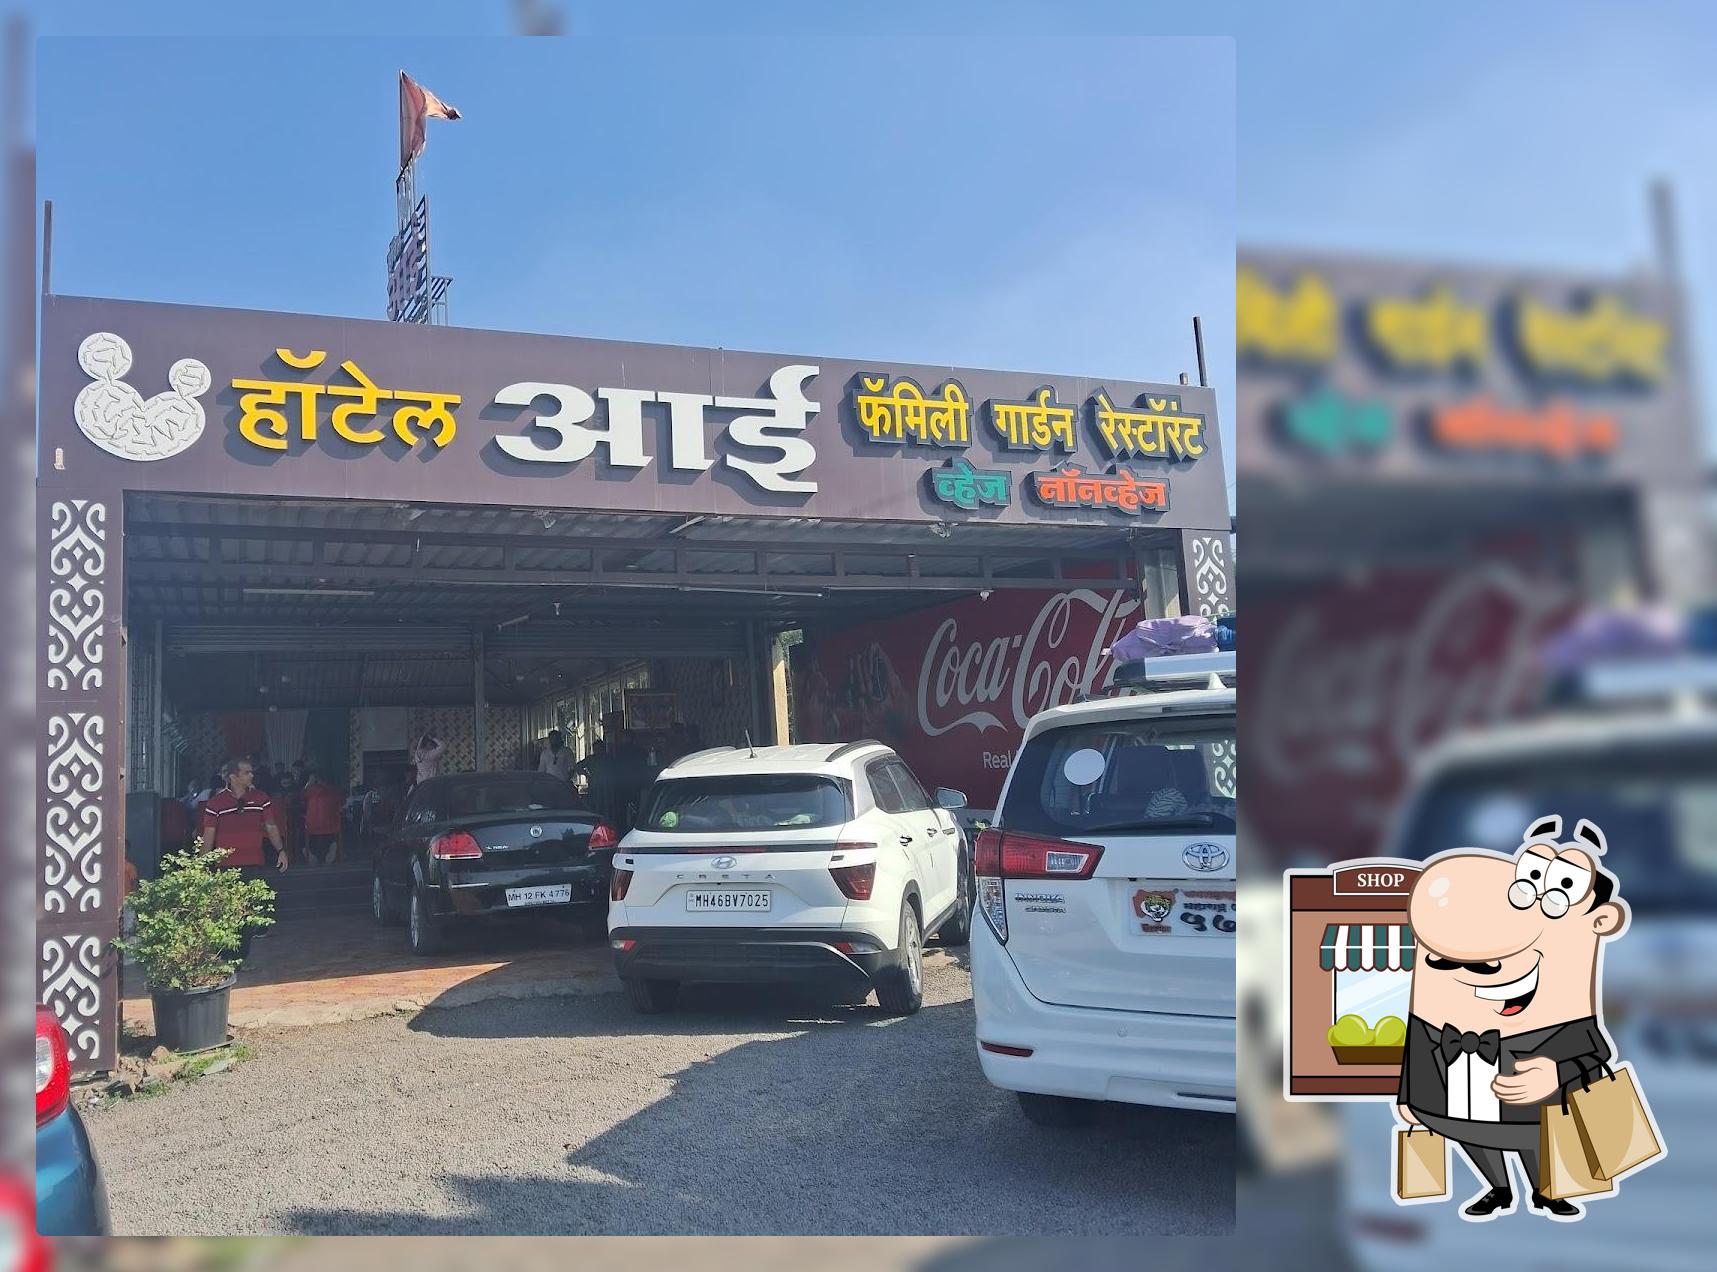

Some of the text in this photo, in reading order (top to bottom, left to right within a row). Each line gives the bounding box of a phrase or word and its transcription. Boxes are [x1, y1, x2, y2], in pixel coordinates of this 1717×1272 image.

[232, 348, 821, 493] हॉटेल आई
[857, 376, 1204, 455] फॅमिली गार्डन रेस्टॉरंट
[936, 466, 1167, 510] व्हेज नॉनव्हेज
[917, 589, 1140, 736] Coca-Col
[982, 749, 1012, 769] Real
[508, 892, 522, 902] MH
[524, 892, 533, 900] 12
[535, 890, 547, 899] FK
[695, 894, 769, 908] MH46BV7025
